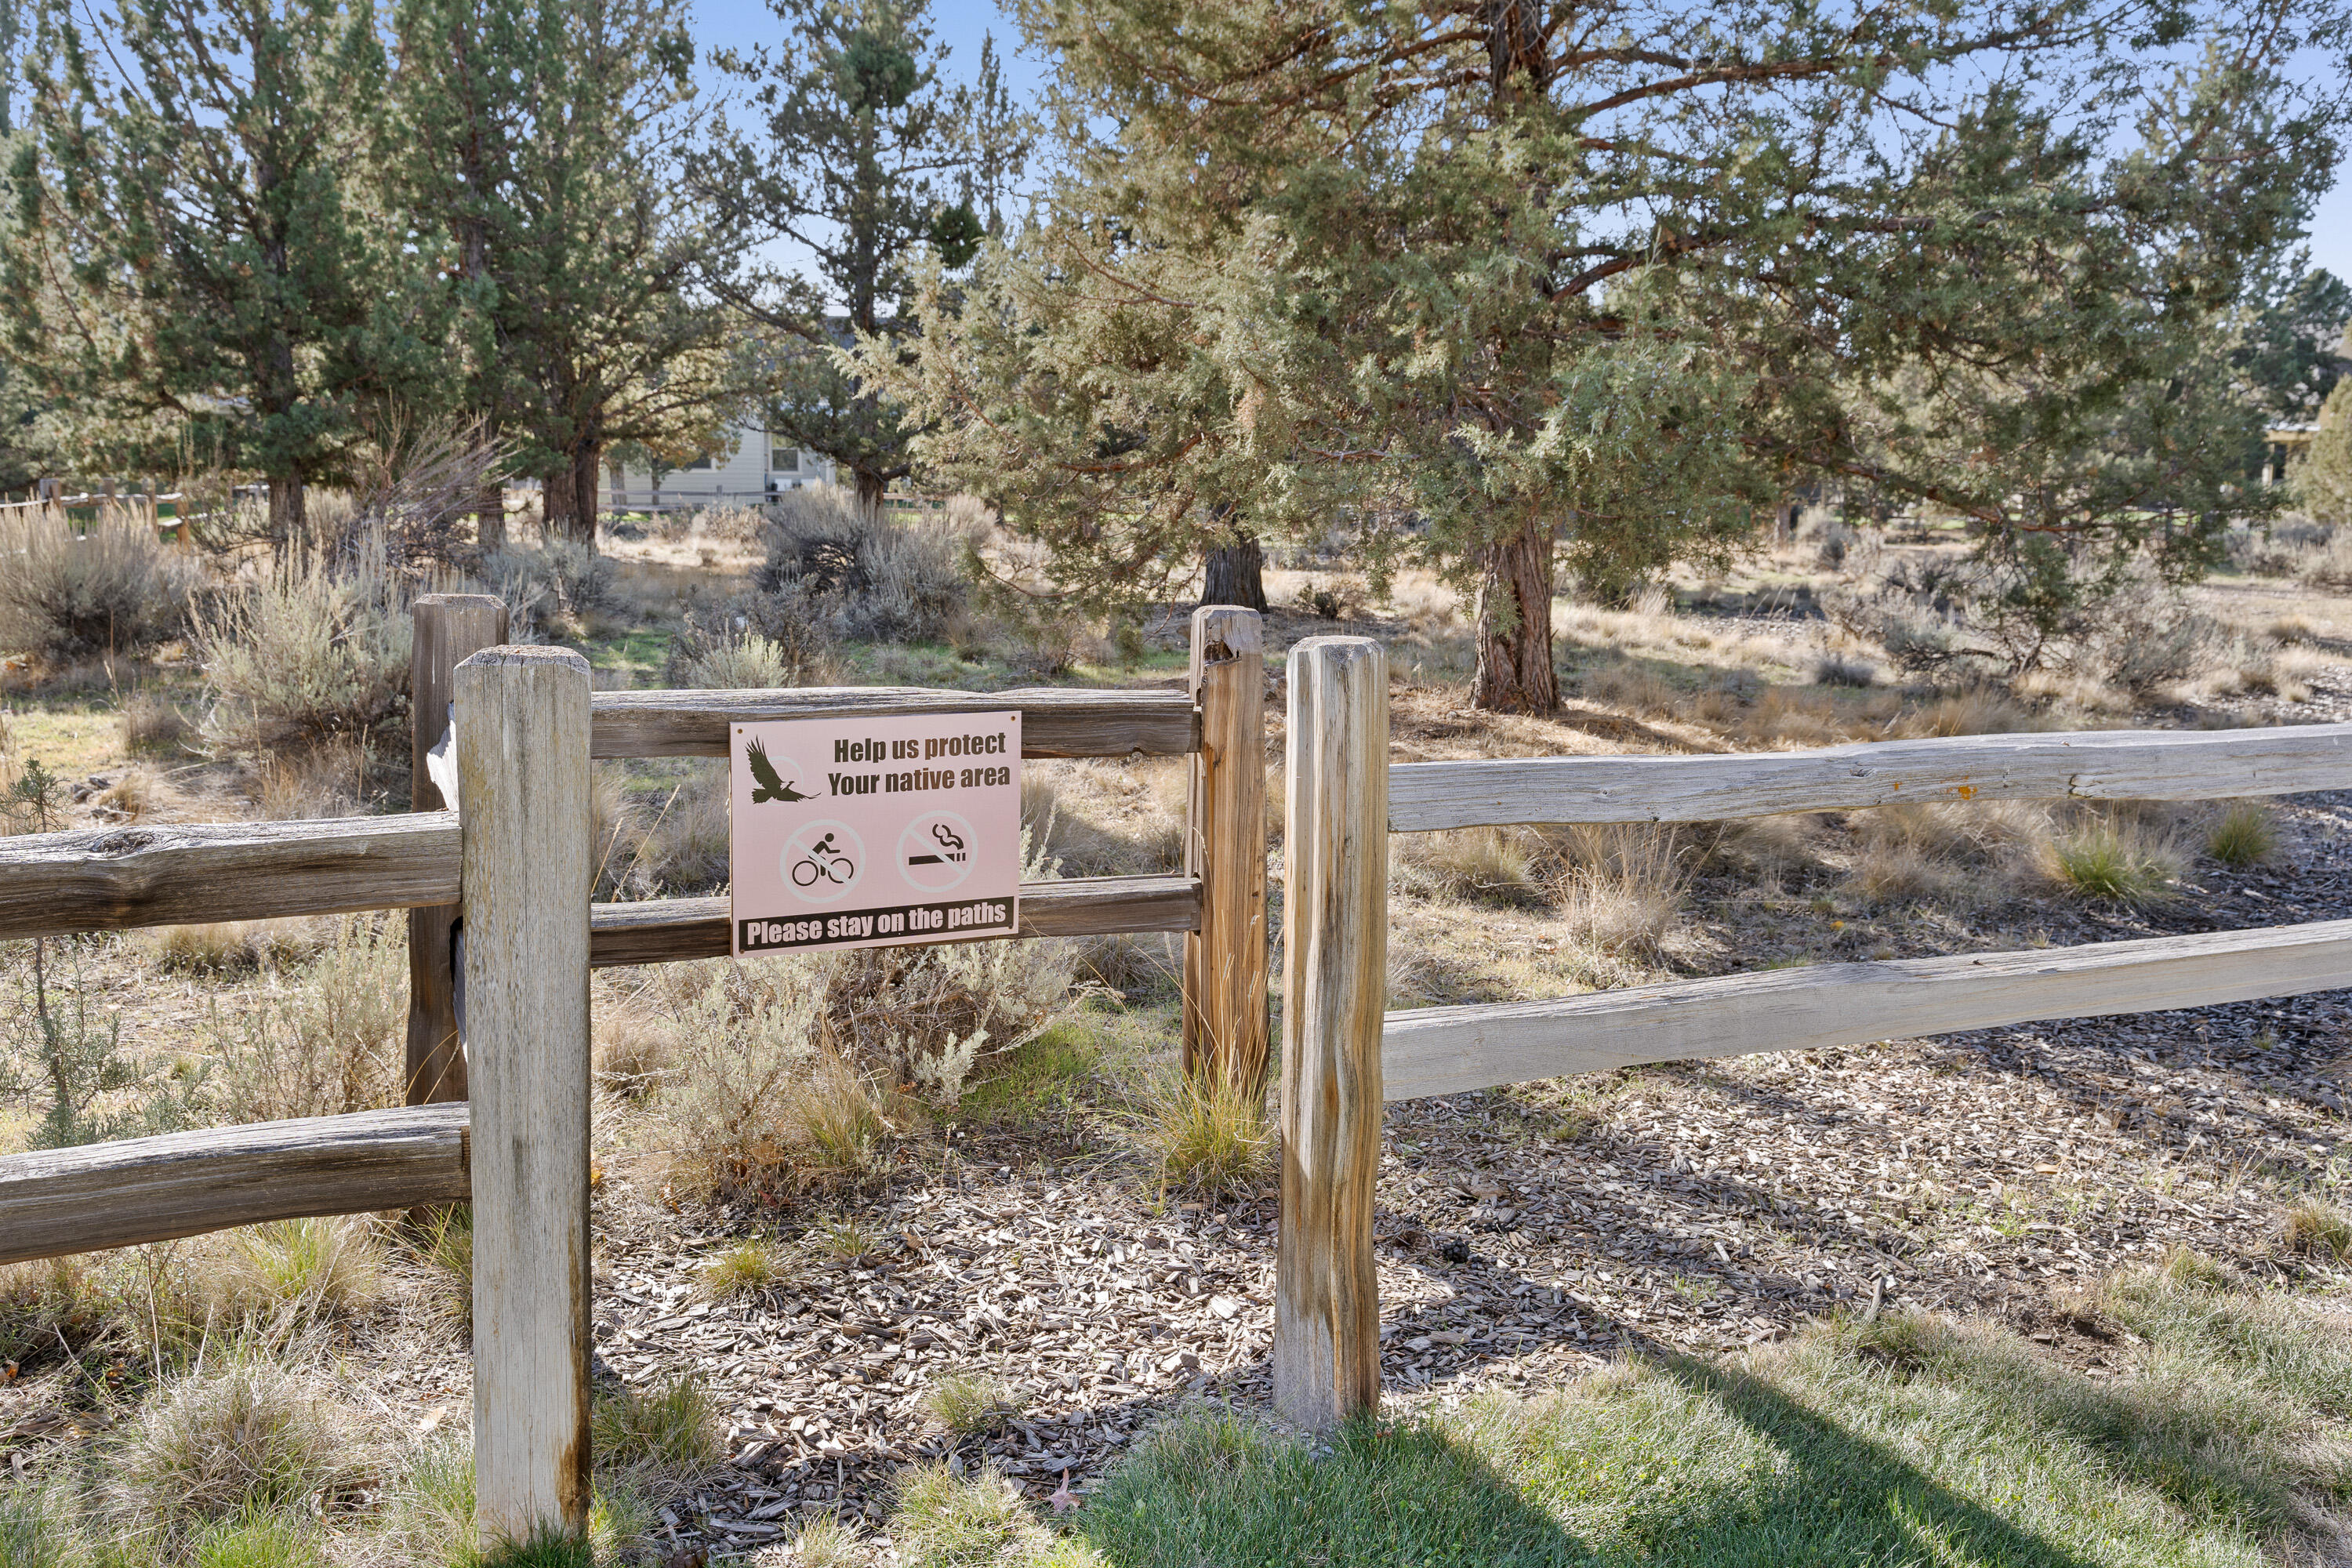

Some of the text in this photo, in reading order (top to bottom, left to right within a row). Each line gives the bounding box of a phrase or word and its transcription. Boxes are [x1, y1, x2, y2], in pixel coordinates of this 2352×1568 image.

[834, 732, 1006, 764] Help us protect
[828, 766, 1011, 796] Your native area
[747, 902, 1006, 946] Please stay on the paths
